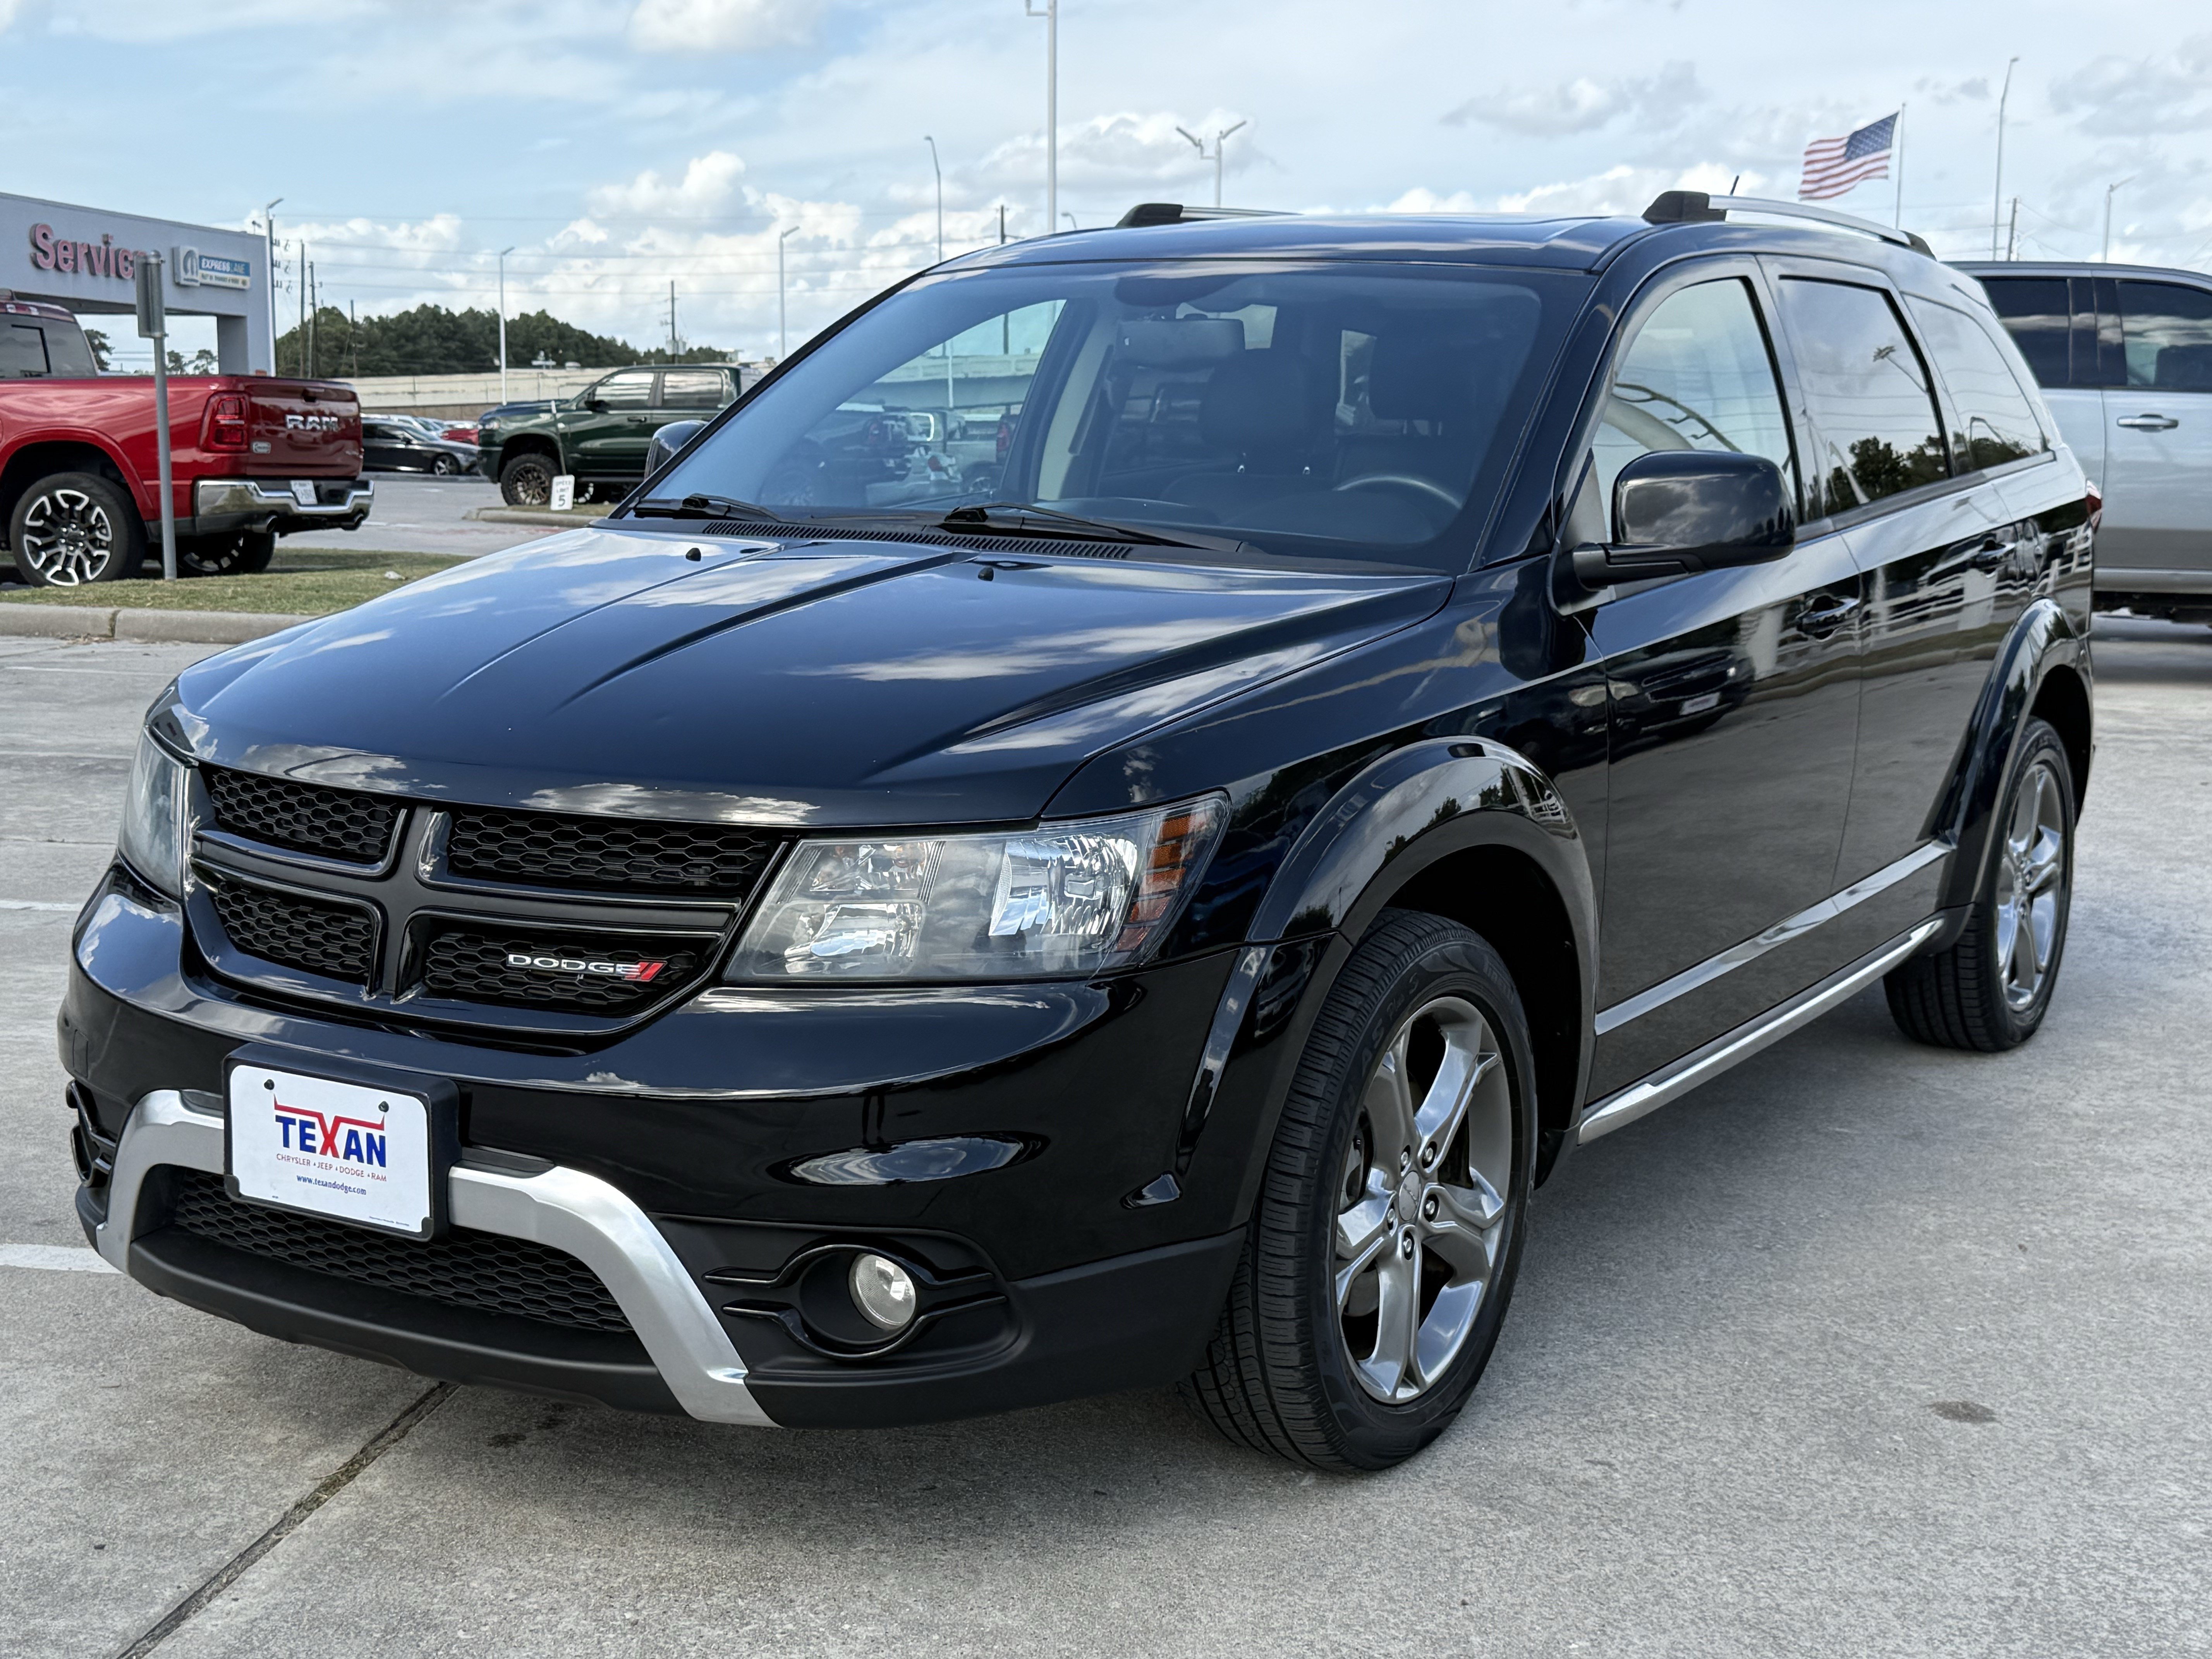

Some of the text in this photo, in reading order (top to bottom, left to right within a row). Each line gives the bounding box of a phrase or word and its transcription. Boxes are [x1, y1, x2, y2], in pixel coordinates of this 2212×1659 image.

[30, 223, 147, 280] Servic
[201, 258, 230, 273] EXPRESS
[285, 414, 339, 432] RAM
[558, 494, 566, 507] 5
[508, 954, 641, 976] DODGE
[274, 1103, 386, 1168] TEXAN
[276, 1153, 387, 1182] CHRYSLER JEEP DODGE RAM
[296, 1175, 367, 1195] www.texandodge.com
